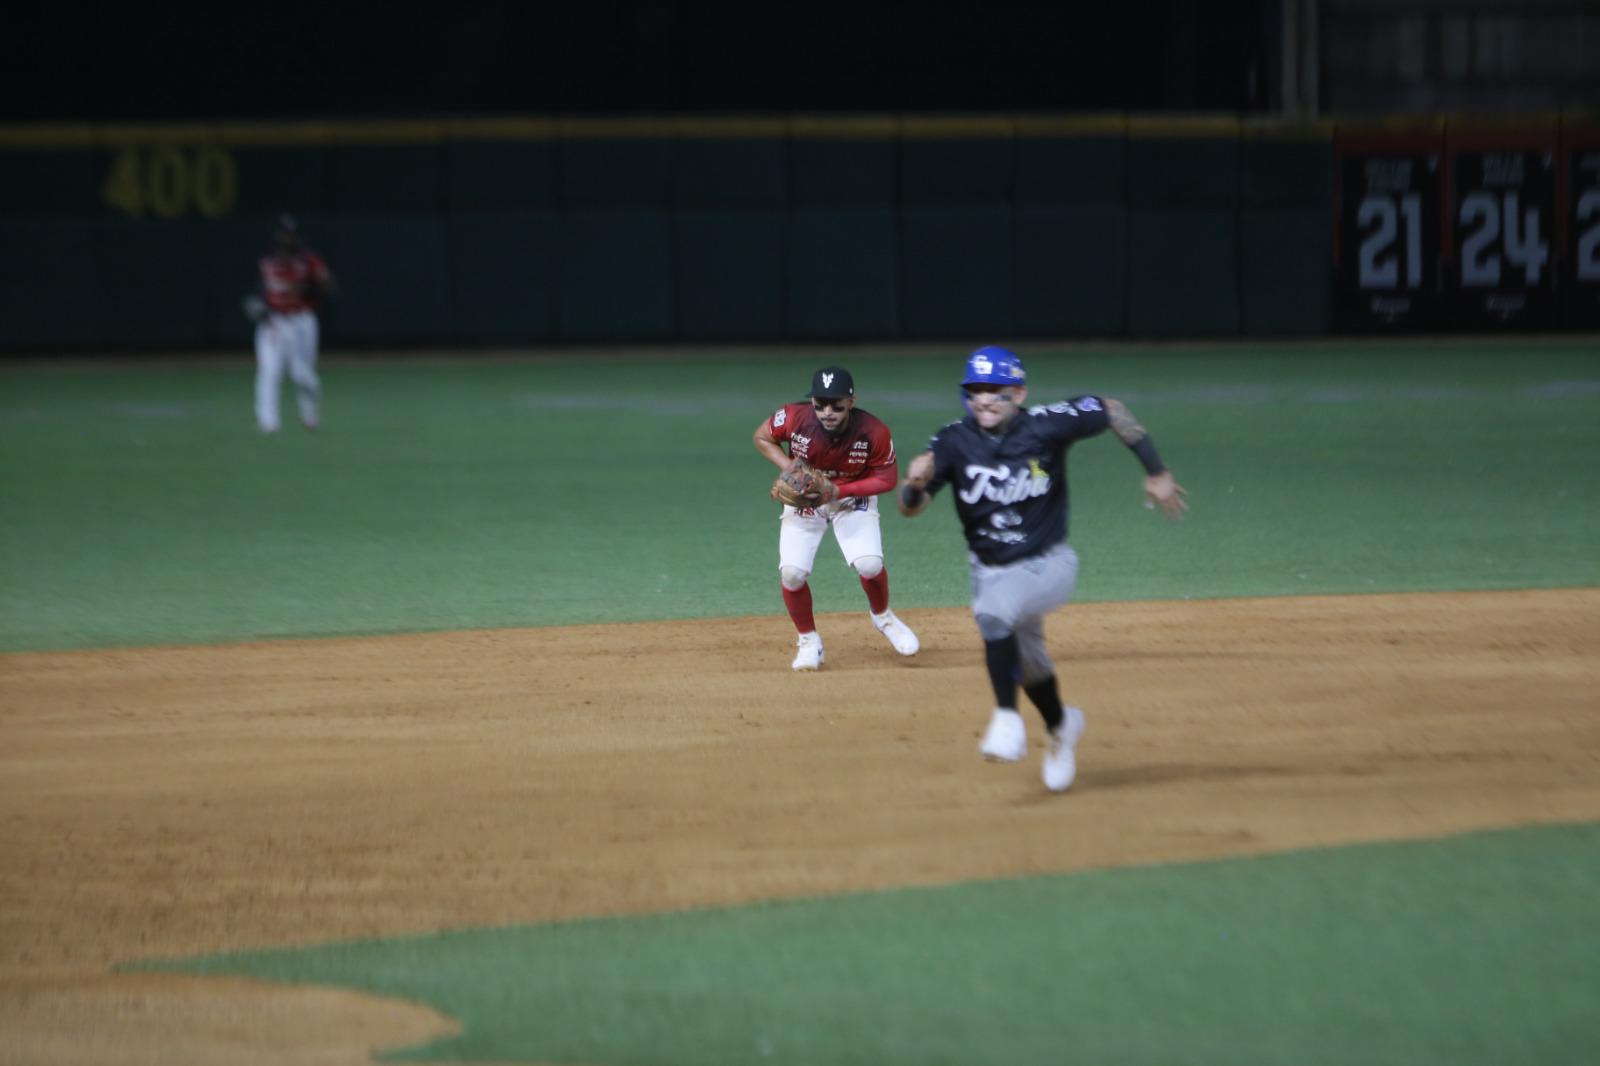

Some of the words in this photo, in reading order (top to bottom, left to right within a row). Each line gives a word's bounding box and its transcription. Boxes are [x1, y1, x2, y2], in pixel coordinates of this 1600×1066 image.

[102, 146, 239, 217] 400
[1357, 194, 1422, 288] 21
[1459, 192, 1548, 287] 24
